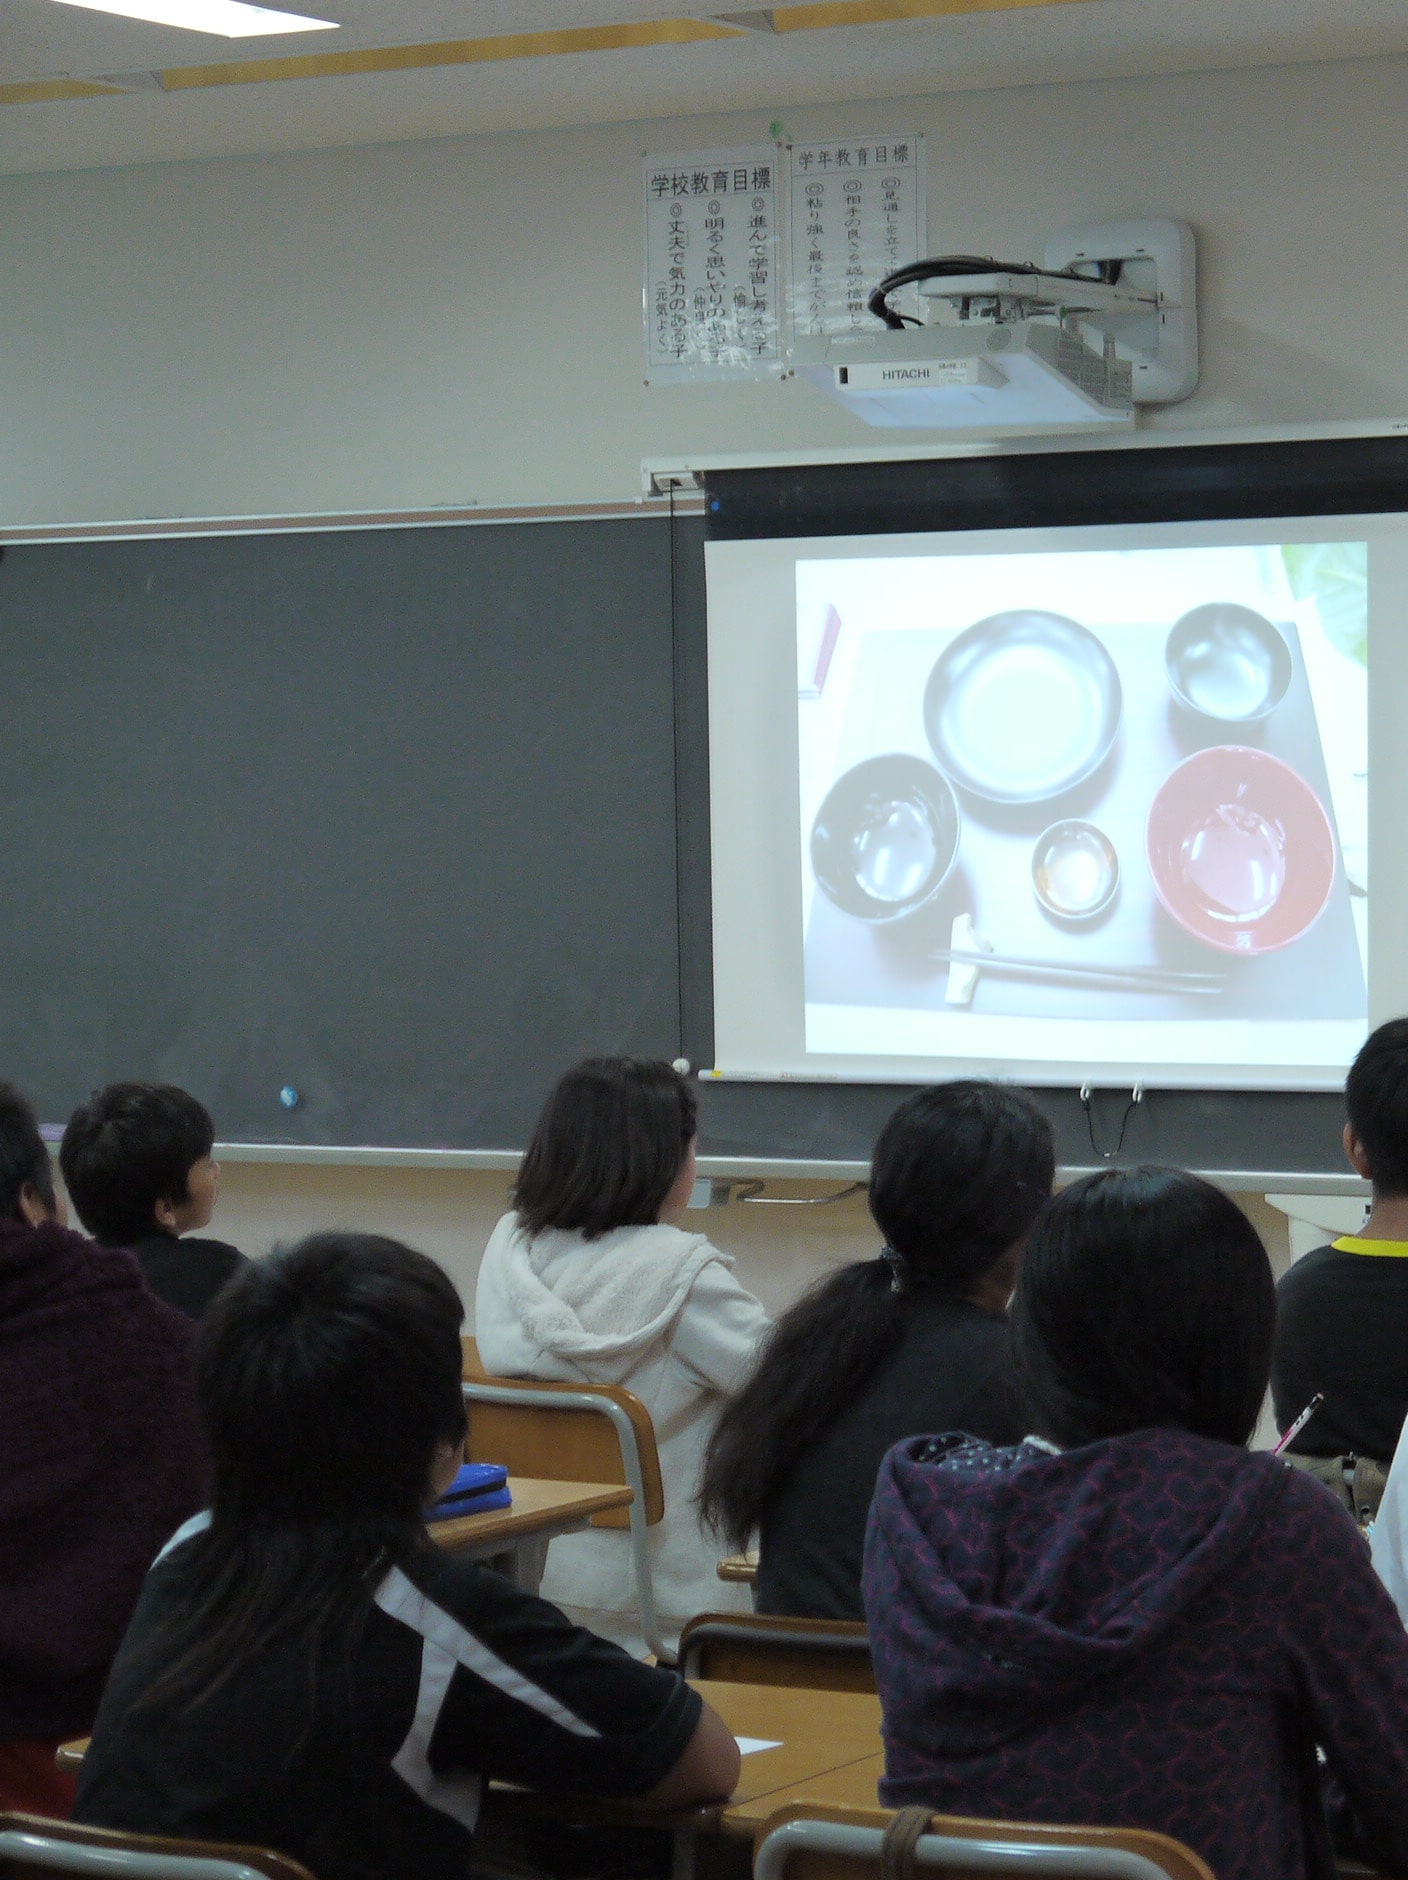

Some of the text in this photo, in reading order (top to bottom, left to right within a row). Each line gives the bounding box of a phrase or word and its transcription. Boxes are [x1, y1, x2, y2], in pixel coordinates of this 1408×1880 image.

[799, 143, 909, 171] 学年教育目標
[651, 166, 771, 198] 学校教育目標
[882, 368, 930, 380] HITACHI
